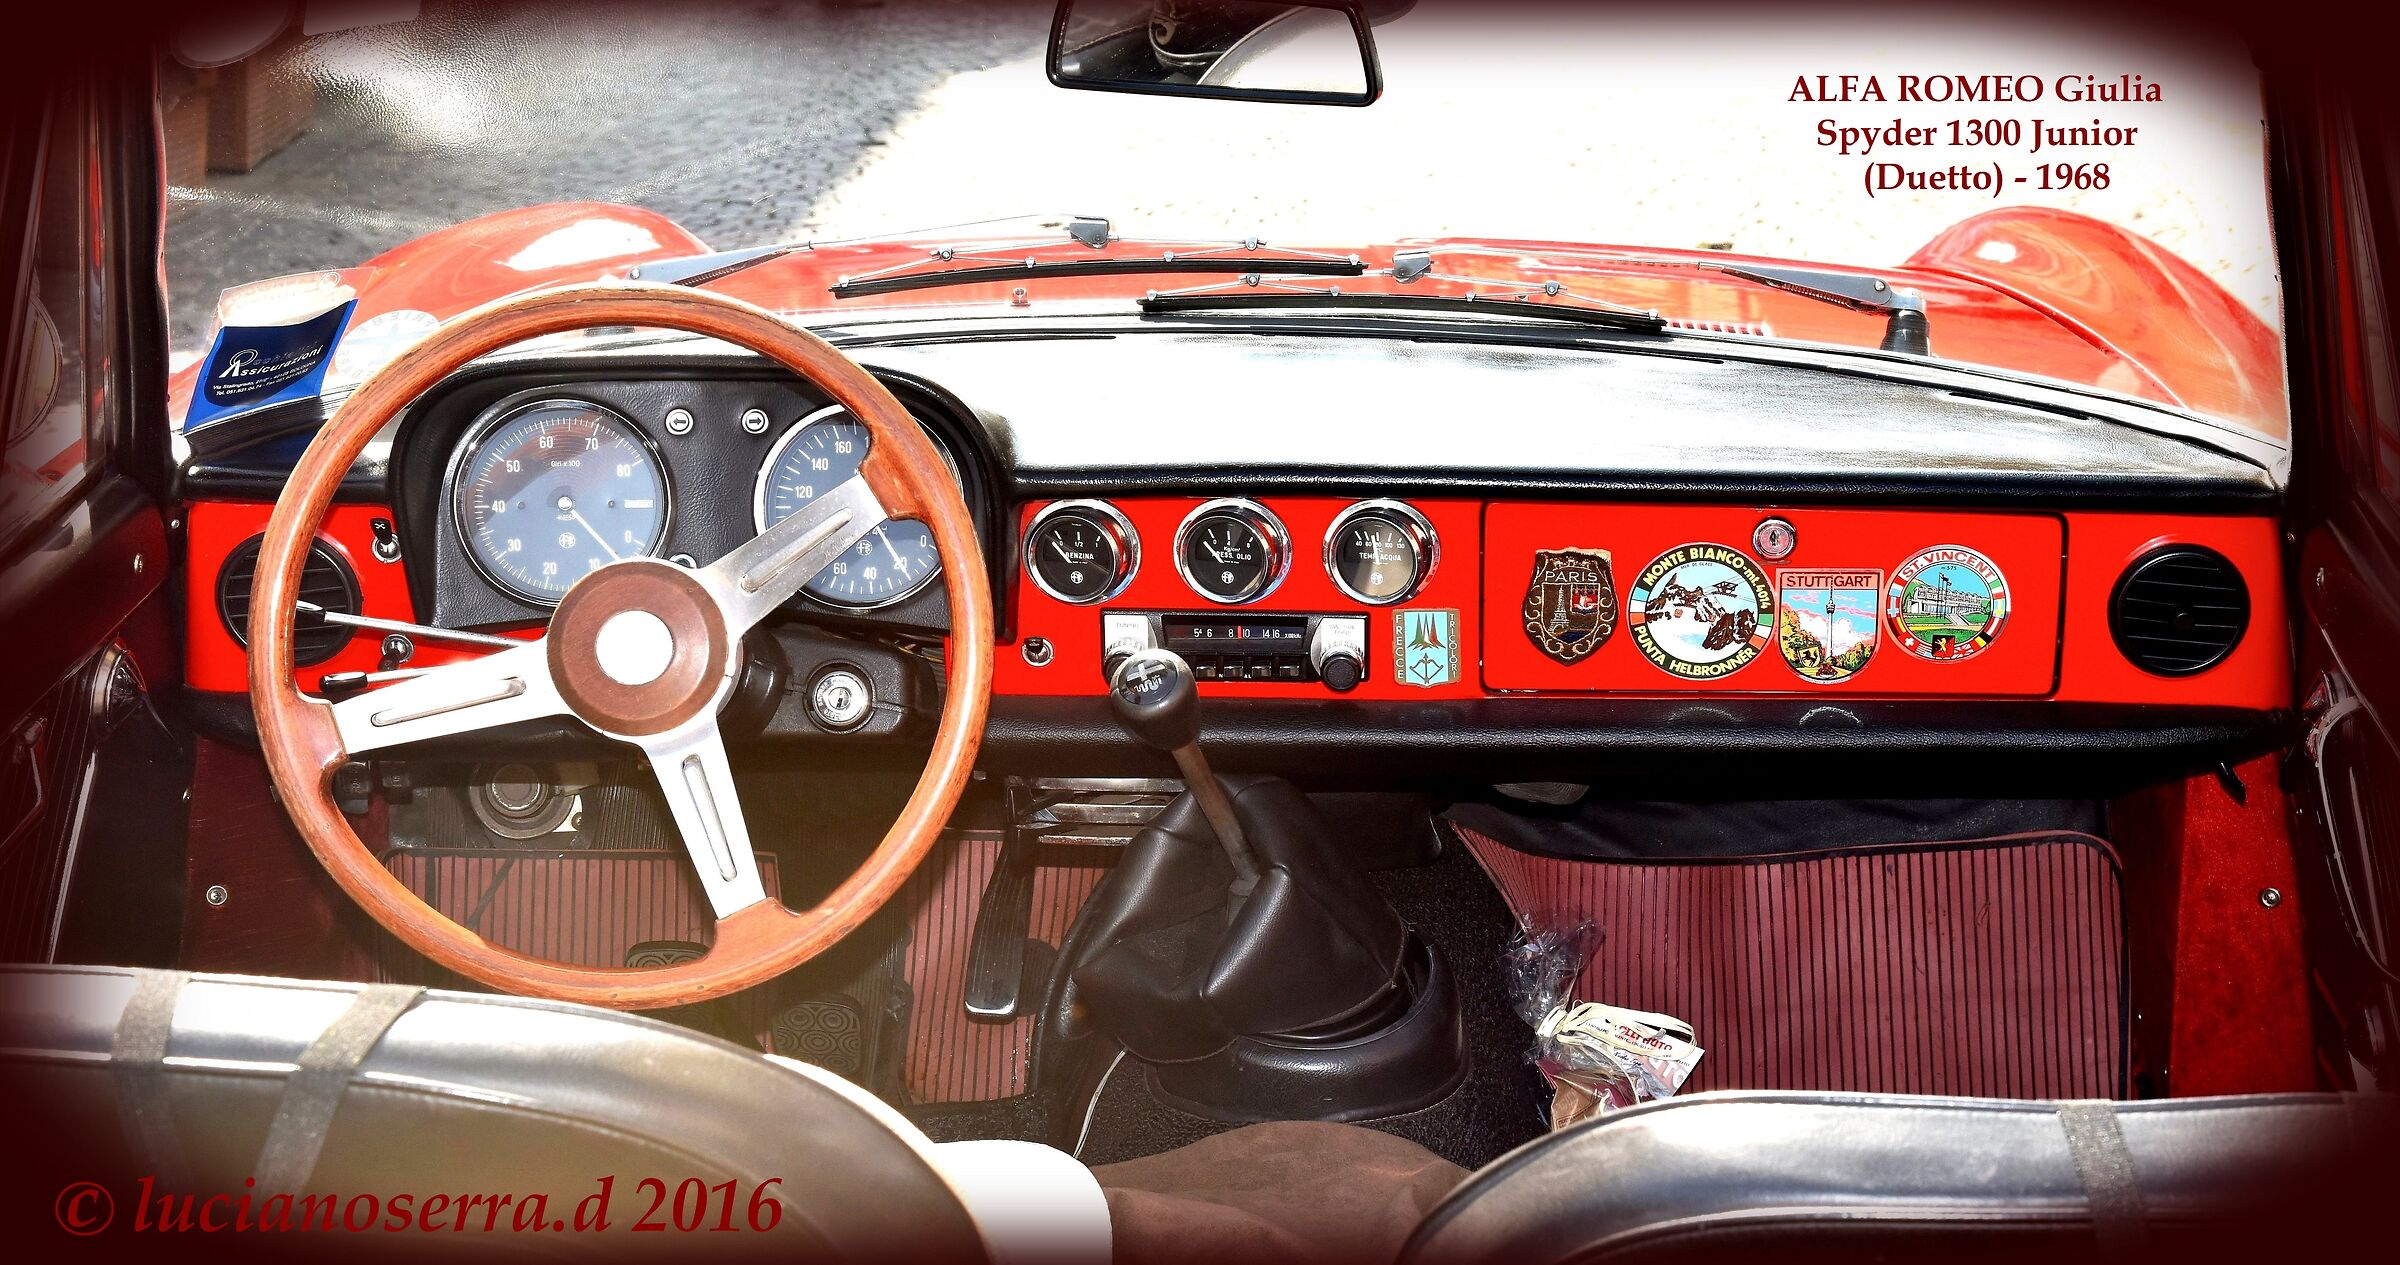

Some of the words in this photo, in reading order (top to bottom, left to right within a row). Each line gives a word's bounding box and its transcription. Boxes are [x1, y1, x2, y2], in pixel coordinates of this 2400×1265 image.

[540, 436, 553, 449] 60
[585, 438, 598, 450] 70
[835, 441, 852, 454] 160
[506, 460, 520, 473] 50
[617, 464, 631, 477] 80
[811, 458, 829, 471] 140
[795, 486, 813, 499] 120
[491, 501, 506, 513] 40
[625, 530, 632, 543] 0
[920, 535, 927, 547] 0
[507, 539, 521, 551] 30
[543, 562, 557, 574] 20
[833, 563, 847, 575] 60
[1642, 551, 1686, 587] MONTE
[1902, 560, 1924, 579] ST.
[1923, 551, 1996, 580] VINCENT
[863, 567, 877, 580] 40
[1544, 571, 1598, 582] PARIS
[1786, 575, 1873, 588] STUTTGART
[1206, 628, 1213, 638] 6
[1228, 628, 1234, 638] 8
[1242, 629, 1251, 638] 10
[1262, 629, 1270, 638] 14
[1272, 629, 1281, 639] 16
[1395, 614, 1404, 679] FRECCE
[1448, 613, 1458, 678] TRICOLORI
[1633, 625, 1666, 666] PUNTA
